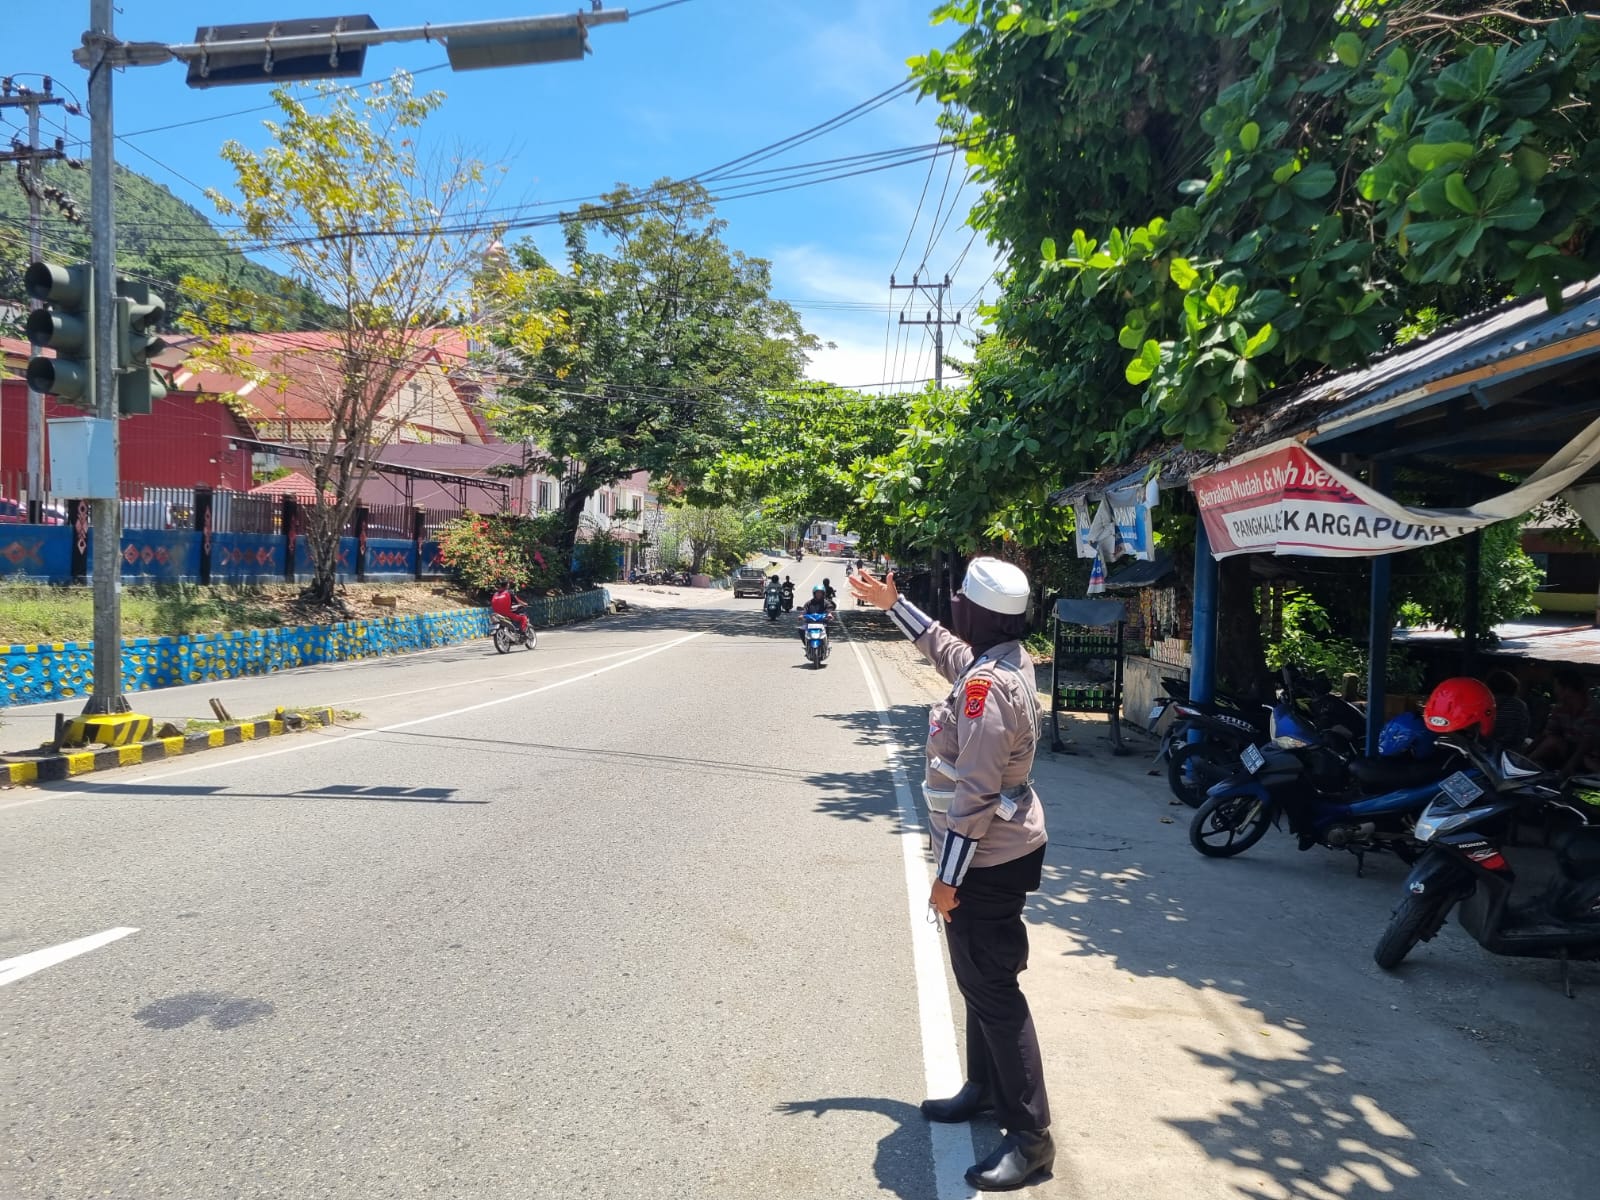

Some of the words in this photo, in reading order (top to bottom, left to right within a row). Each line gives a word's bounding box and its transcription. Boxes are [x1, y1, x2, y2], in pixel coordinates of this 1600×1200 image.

[1199, 484, 1233, 507] Semakin
[1231, 472, 1264, 500] Mudah
[1263, 469, 1274, 490] &
[1233, 513, 1280, 538] PANGKALA
